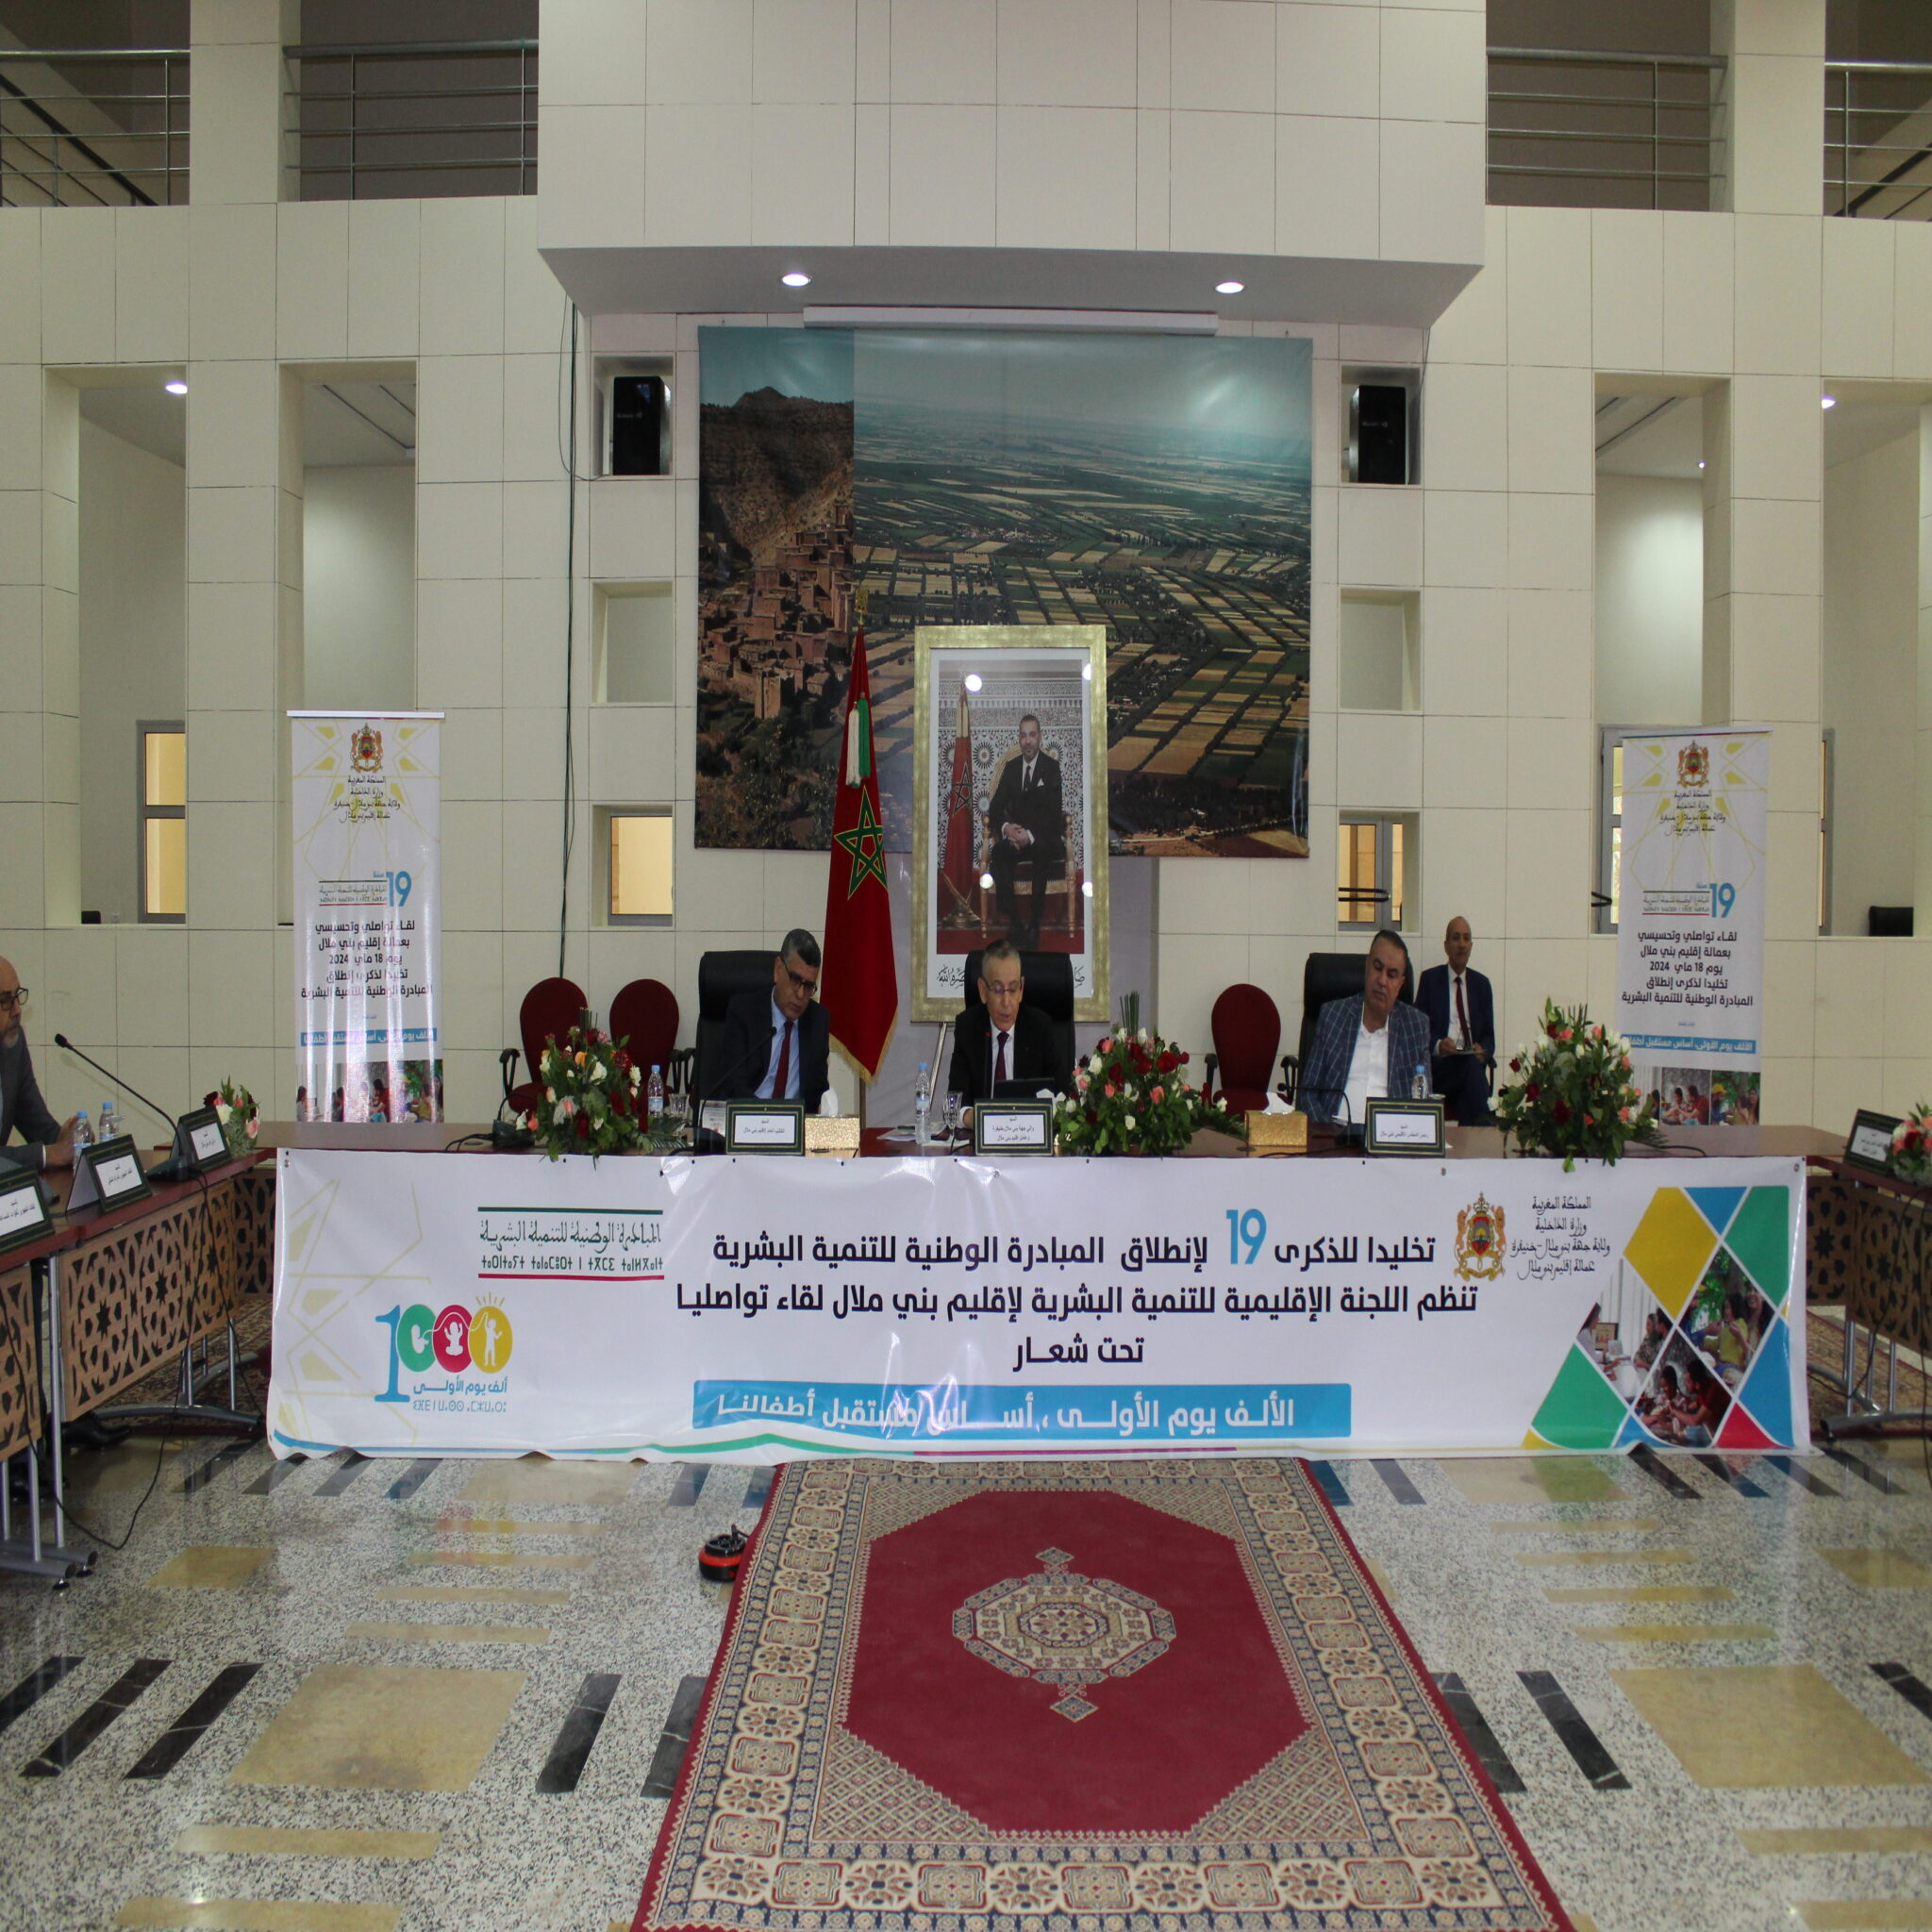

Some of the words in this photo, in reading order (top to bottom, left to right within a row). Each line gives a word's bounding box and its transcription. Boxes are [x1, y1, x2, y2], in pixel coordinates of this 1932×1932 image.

[386, 871, 412, 907] 19
[1709, 883, 1736, 918] 19
[1638, 930, 1680, 943] وتحسيسي
[1683, 930, 1715, 943] تواصلي
[1717, 931, 1737, 941] لقاء
[328, 953, 349, 964] 2024
[375, 953, 384, 963] 18
[1640, 945, 1657, 958] ملال
[1660, 945, 1675, 958] بني
[1678, 945, 1702, 959] إقليم
[1703, 946, 1731, 959] بعمالة
[1650, 960, 1670, 972] 2024
[1674, 962, 1692, 974] ماي
[1695, 962, 1704, 973] 18
[1706, 965, 1724, 975] يوم
[300, 986, 333, 1000] البشرة
[400, 984, 434, 998] امبادرة
[1622, 991, 1652, 1005] البشرية
[1675, 977, 1701, 991] لذكرى
[1704, 977, 1728, 991] تخليدا
[1654, 992, 1683, 1005] للتنمية
[1685, 993, 1717, 1008] الوطنية
[1719, 995, 1754, 1008] المبادرة
[713, 1229, 803, 1269] البشرية
[1226, 1208, 1268, 1265] 19
[811, 1235, 897, 1270] للتنمية
[905, 1236, 999, 1272] الوطنية
[1008, 1236, 1105, 1272] المبادرة
[1121, 1236, 1208, 1274] لإنطلاق
[1274, 1236, 1358, 1273] للذكرى
[1368, 1236, 1437, 1271] تخليدا
[676, 1282, 769, 1319] تواصليا
[775, 1283, 824, 1311] لقاء
[832, 1284, 884, 1319] ملال
[891, 1286, 939, 1321] بني
[946, 1286, 1023, 1324] لإقليم
[1031, 1282, 1123, 1323] البشرية
[1131, 1286, 1216, 1321] للتنمية
[1224, 1286, 1332, 1323] الإقليمية
[1340, 1286, 1408, 1319] اللجنة
[1417, 1286, 1478, 1321] تنظم
[1012, 1332, 1089, 1373] شعار
[1097, 1337, 1144, 1364] تحت
[465, 1382, 486, 1396] يوم
[717, 1388, 817, 1417] أطفالنا
[822, 1398, 920, 1430] مستقبل
[1168, 1401, 1217, 1437] يوم
[1224, 1391, 1295, 1428] الألف
